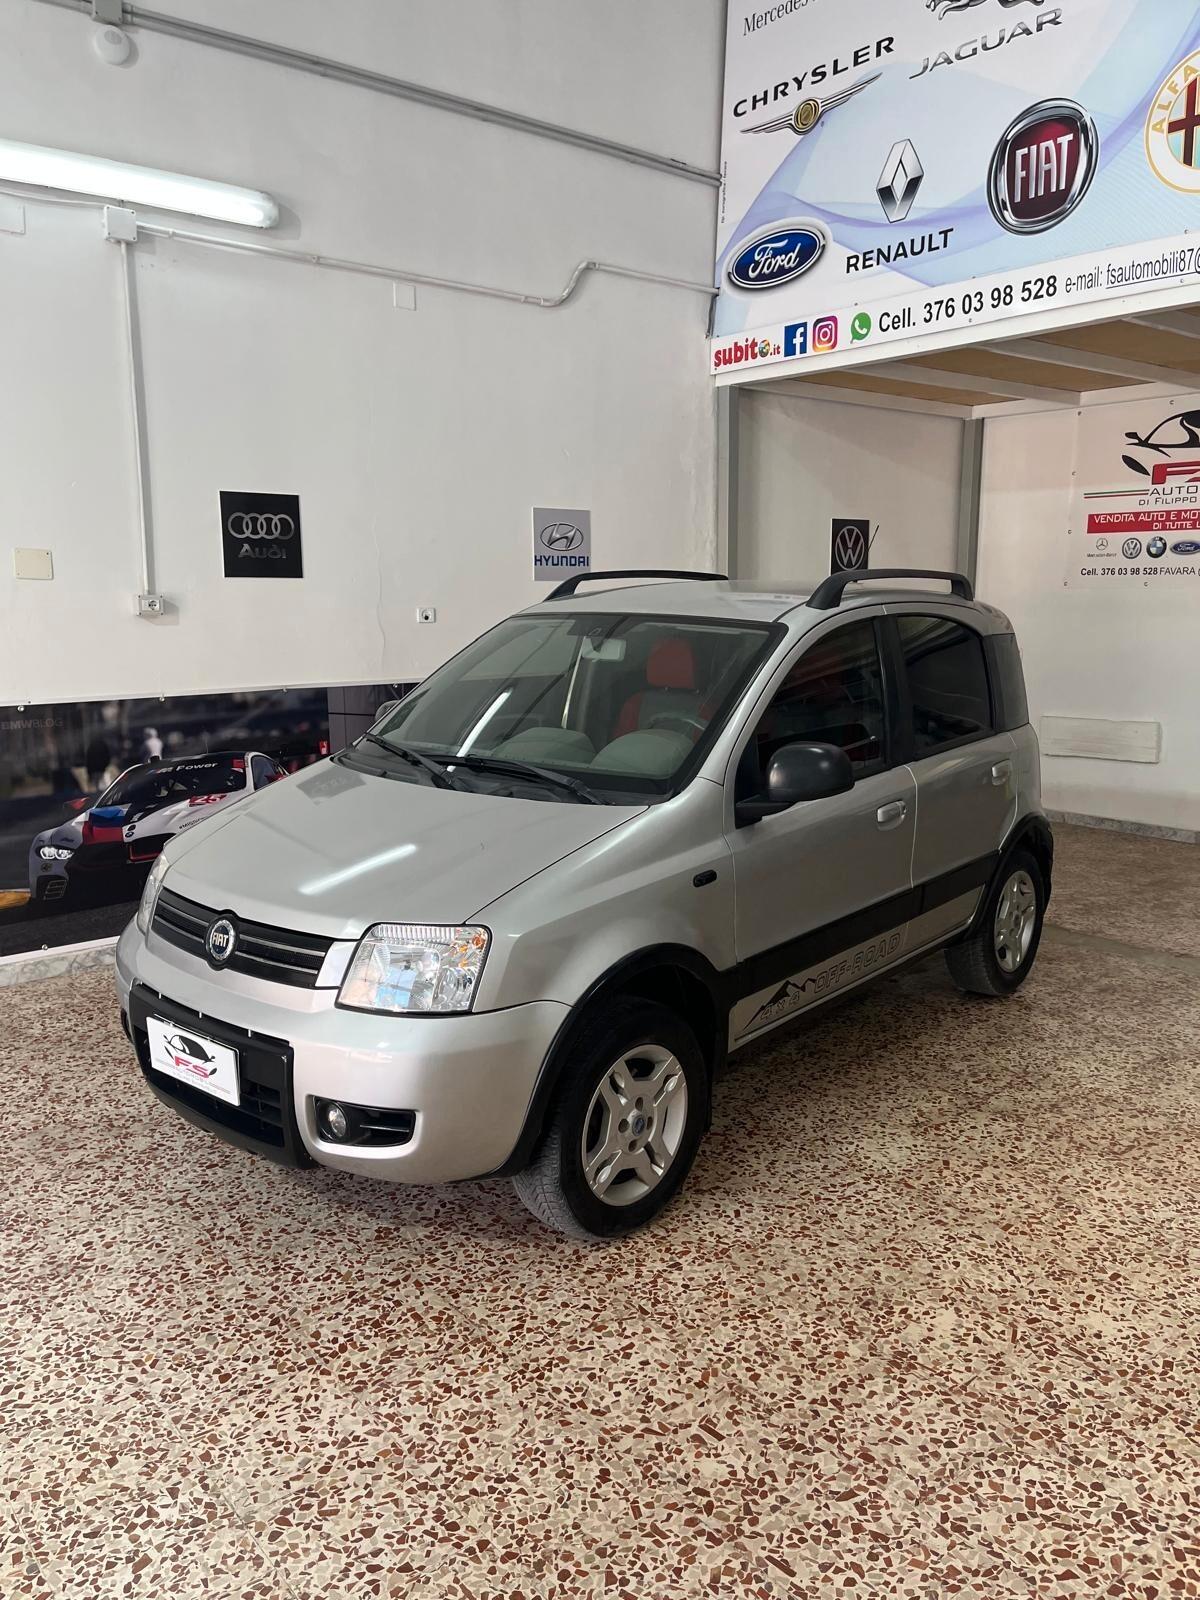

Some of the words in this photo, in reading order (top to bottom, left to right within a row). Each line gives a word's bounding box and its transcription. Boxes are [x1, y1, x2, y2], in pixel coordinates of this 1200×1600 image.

[743, 0, 815, 36] Mercedes
[909, 8, 1063, 79] JAGUAR
[733, 36, 895, 118] CHRYSLER
[1151, 65, 1200, 134] ALFA
[1014, 133, 1074, 203] FIAT
[748, 239, 801, 279] Ford
[846, 228, 954, 274] RENAULT
[879, 307, 916, 333] Cell.
[923, 297, 955, 324] 376
[962, 291, 984, 315] 03
[991, 285, 1013, 309] 98
[1020, 275, 1057, 303] 528
[1065, 265, 1103, 293] e-mail:
[1154, 496, 1197, 505] FILIPPO
[1093, 513, 1135, 523] VENDITA
[1138, 511, 1166, 521] AUTO
[1170, 511, 1177, 520] E
[1152, 522, 1162, 530] DI
[1165, 521, 1192, 529] TUTTE
[238, 543, 287, 559] Audi
[534, 554, 590, 567] HYUNDAI
[1080, 567, 1098, 576] Cell.
[1100, 567, 1115, 576] 376
[1117, 567, 1128, 576] 03
[1130, 567, 1140, 576] 98
[1142, 567, 1158, 576] 528
[1159, 567, 1196, 576] FAVARA
[176, 763, 218, 772] Power
[211, 932, 229, 948] FIAT
[814, 933, 900, 994] OFF-ROAD
[174, 1055, 210, 1079] FS
